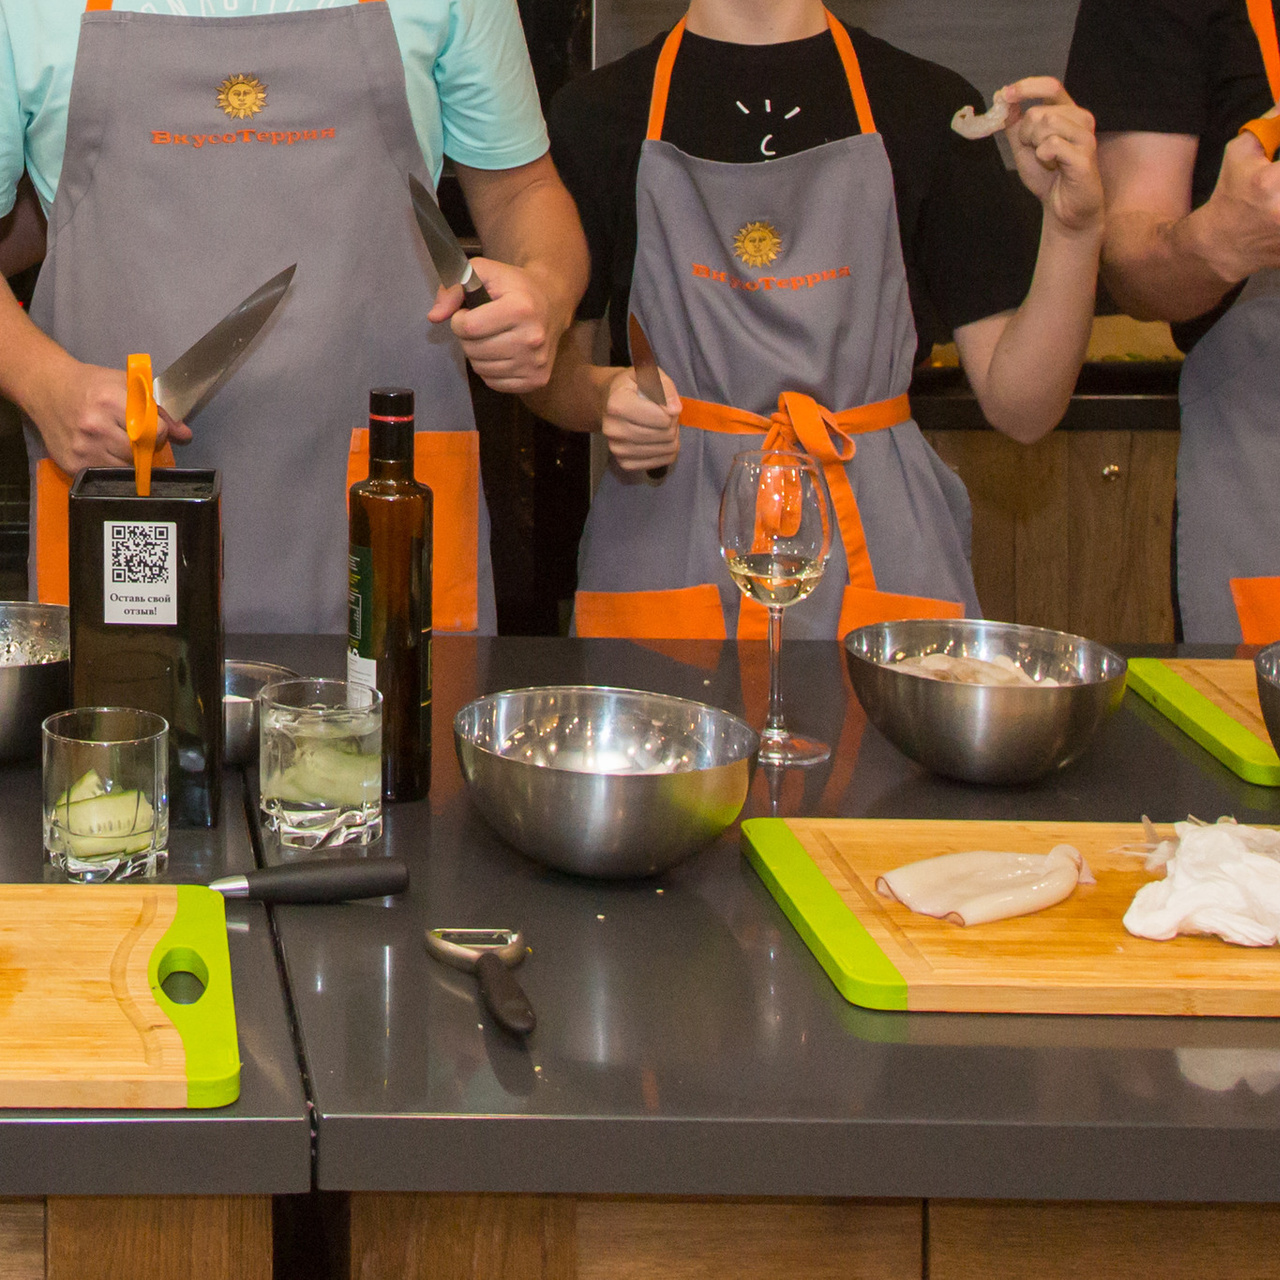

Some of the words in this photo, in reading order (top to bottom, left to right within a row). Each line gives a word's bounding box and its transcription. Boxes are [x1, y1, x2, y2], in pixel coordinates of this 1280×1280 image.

[150, 127, 336, 149] ВкусоТеррия
[109, 592, 146, 603] Оставь
[147, 594, 171, 603] свой
[123, 606, 158, 616] отзыв!
